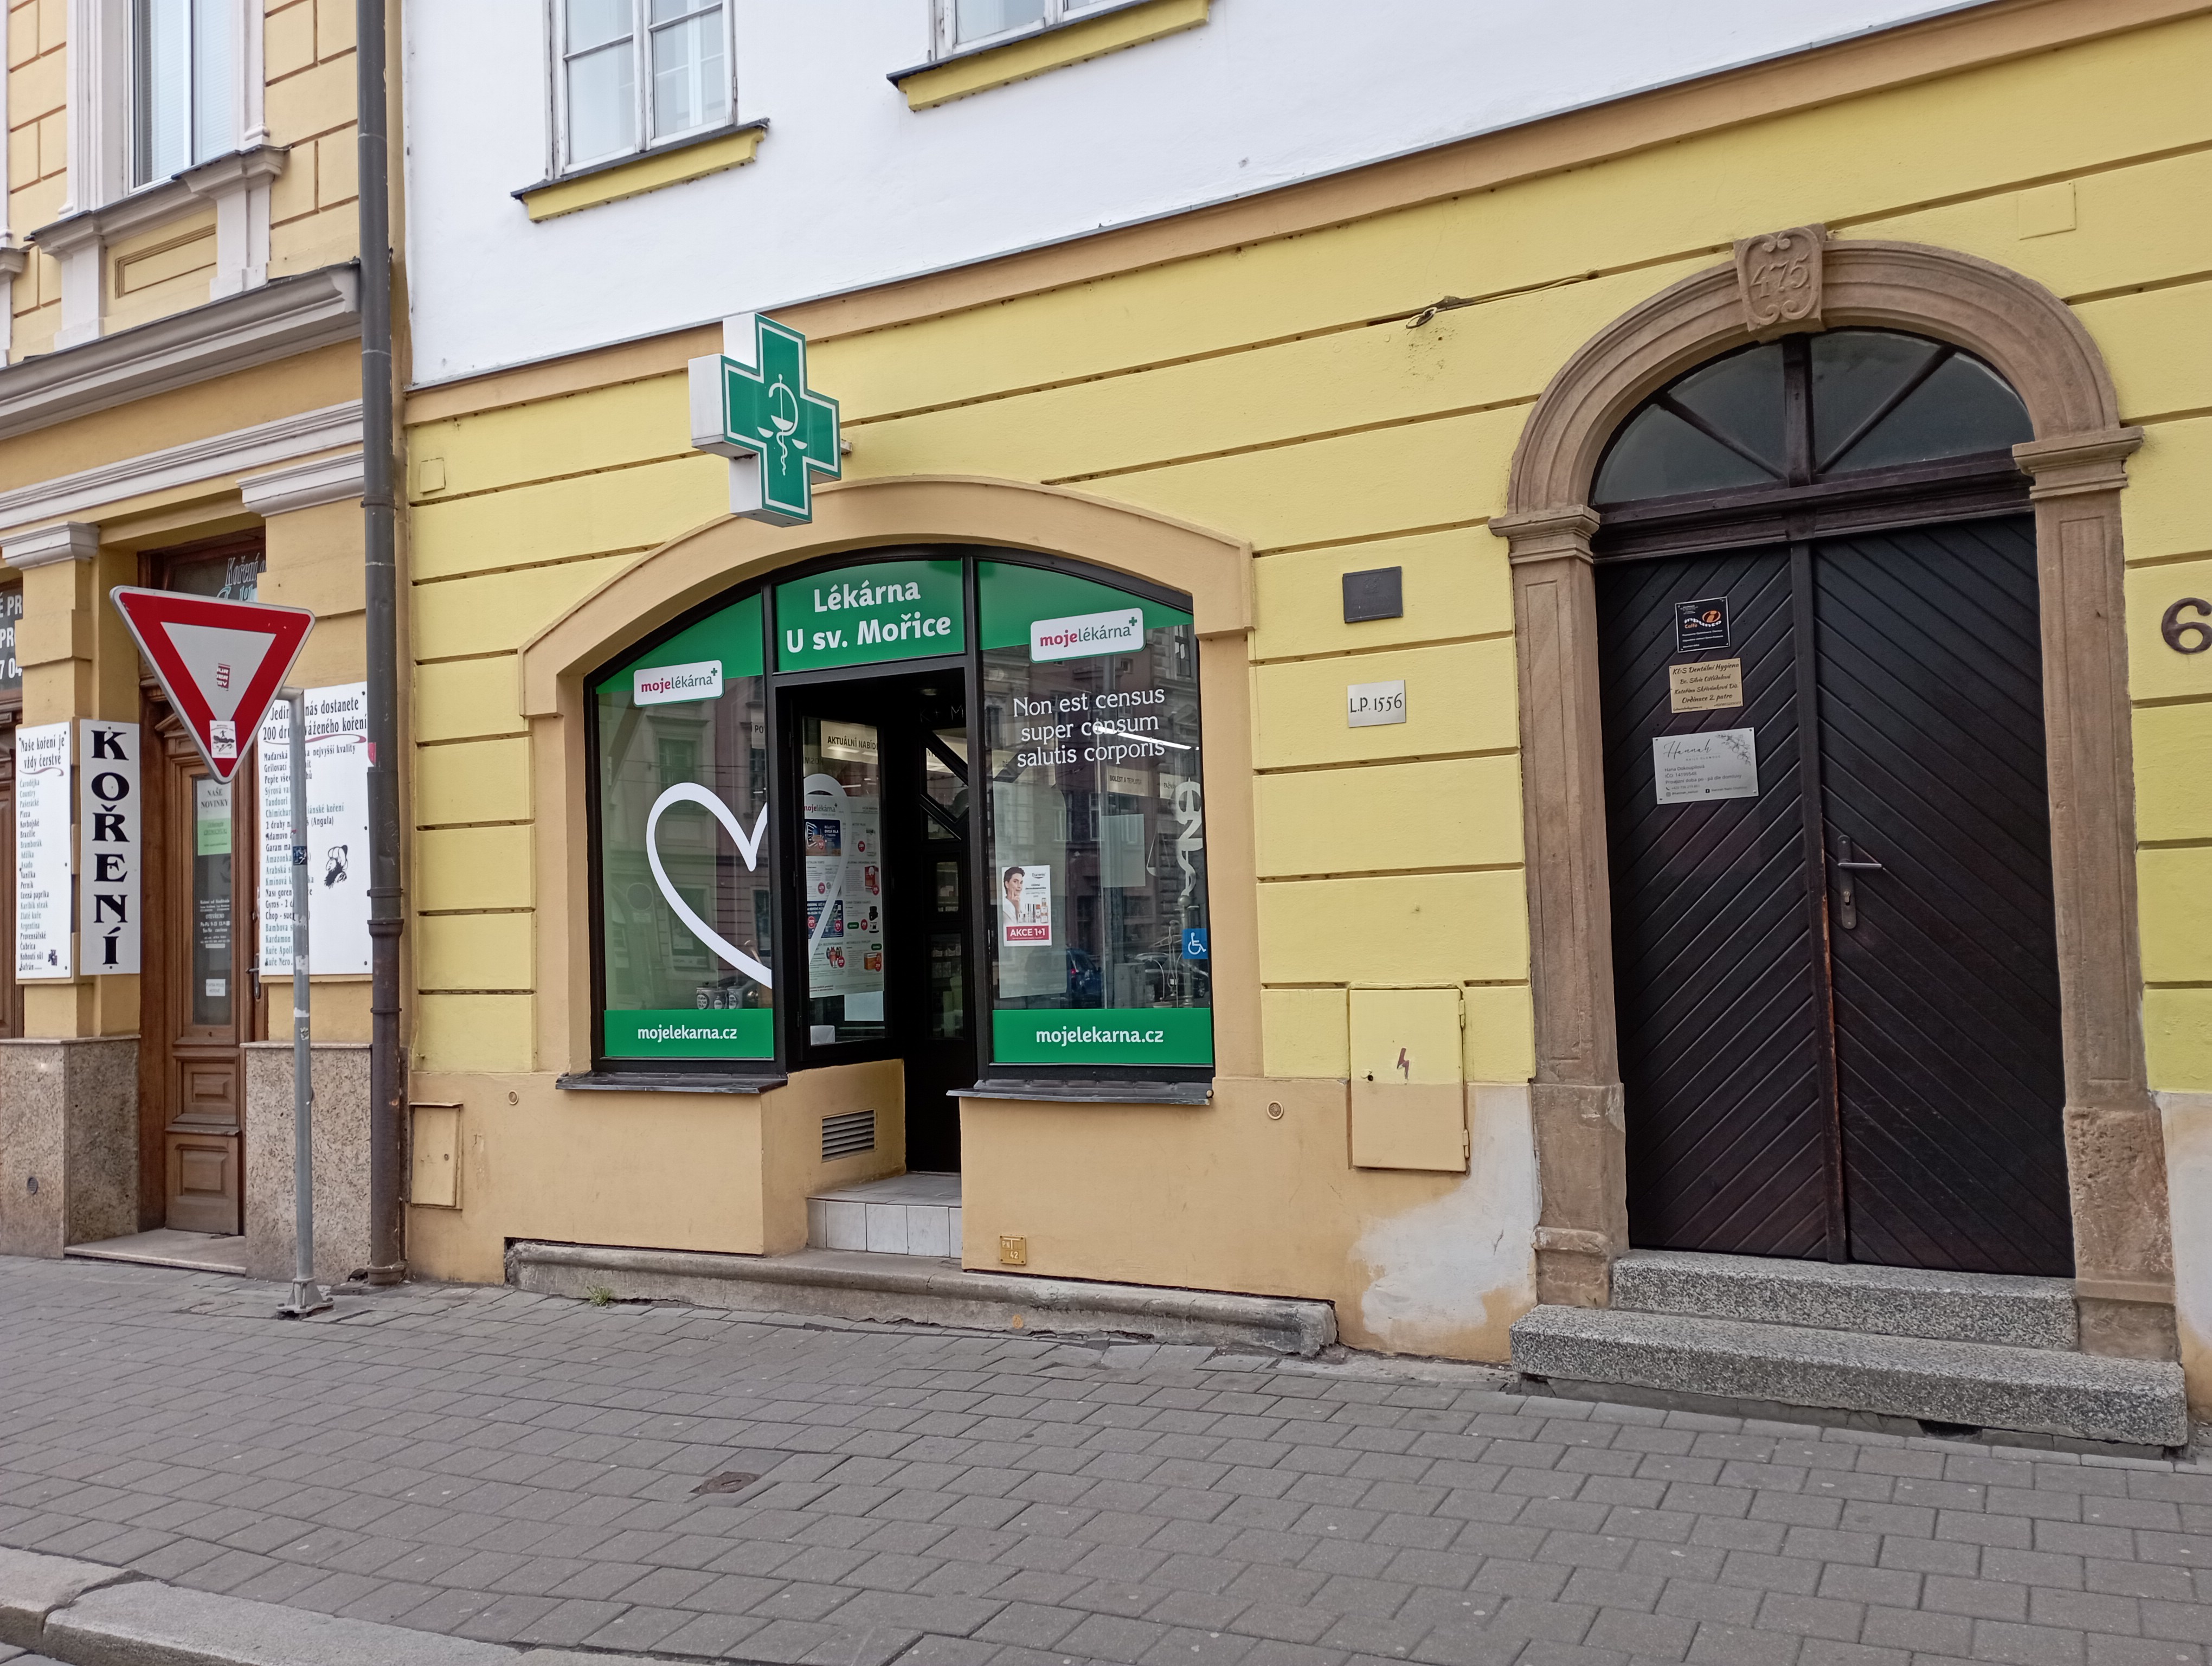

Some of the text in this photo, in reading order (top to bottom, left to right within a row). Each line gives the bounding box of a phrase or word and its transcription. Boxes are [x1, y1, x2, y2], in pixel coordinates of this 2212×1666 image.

[814, 580, 921, 613] Lékárna
[787, 611, 951, 653] U sv. Mořice
[2161, 597, 2212, 655] 6
[1689, 664, 1715, 673] Dentální
[305, 701, 318, 716] nás
[321, 696, 359, 715] dostanete
[1013, 688, 1165, 717] Non est census
[1350, 693, 1403, 713] L.P. 1556
[1682, 696, 1707, 704] Ordinace
[1716, 694, 1733, 702] patro
[263, 726, 276, 741] 200
[342, 714, 367, 732] koření
[1021, 715, 1159, 745] super censum
[21, 733, 65, 753] Naše koření je
[827, 735, 877, 749] AKTUÁLNÍ NABÍD
[1663, 739, 1712, 759] Hannah
[264, 749, 288, 761] Maďarská
[313, 745, 335, 758] nejvyšší
[336, 744, 356, 755] kvality
[1017, 741, 1165, 767] salutis corporis
[24, 751, 61, 771] vždy čerstvé
[264, 761, 287, 772] Grilovací
[265, 774, 278, 785] Pepře
[207, 787, 223, 797] NAŠE
[201, 799, 228, 809] NOVINKY
[266, 797, 288, 806] Tandoori
[326, 802, 344, 813] koření
[271, 820, 285, 830] druhy
[311, 816, 334, 827] (Angula)
[91, 729, 130, 965] KOŘENÍ
[266, 844, 282, 852] Garam
[278, 889, 292, 899] goren
[266, 900, 279, 912] Gyros
[266, 912, 278, 922] Chop
[1010, 928, 1045, 937] AKCE 1+1
[638, 1024, 737, 1043] mojelekarna.cz
[1036, 1026, 1164, 1047] mojelekarna.cz
[1010, 1251, 1019, 1259] 42
